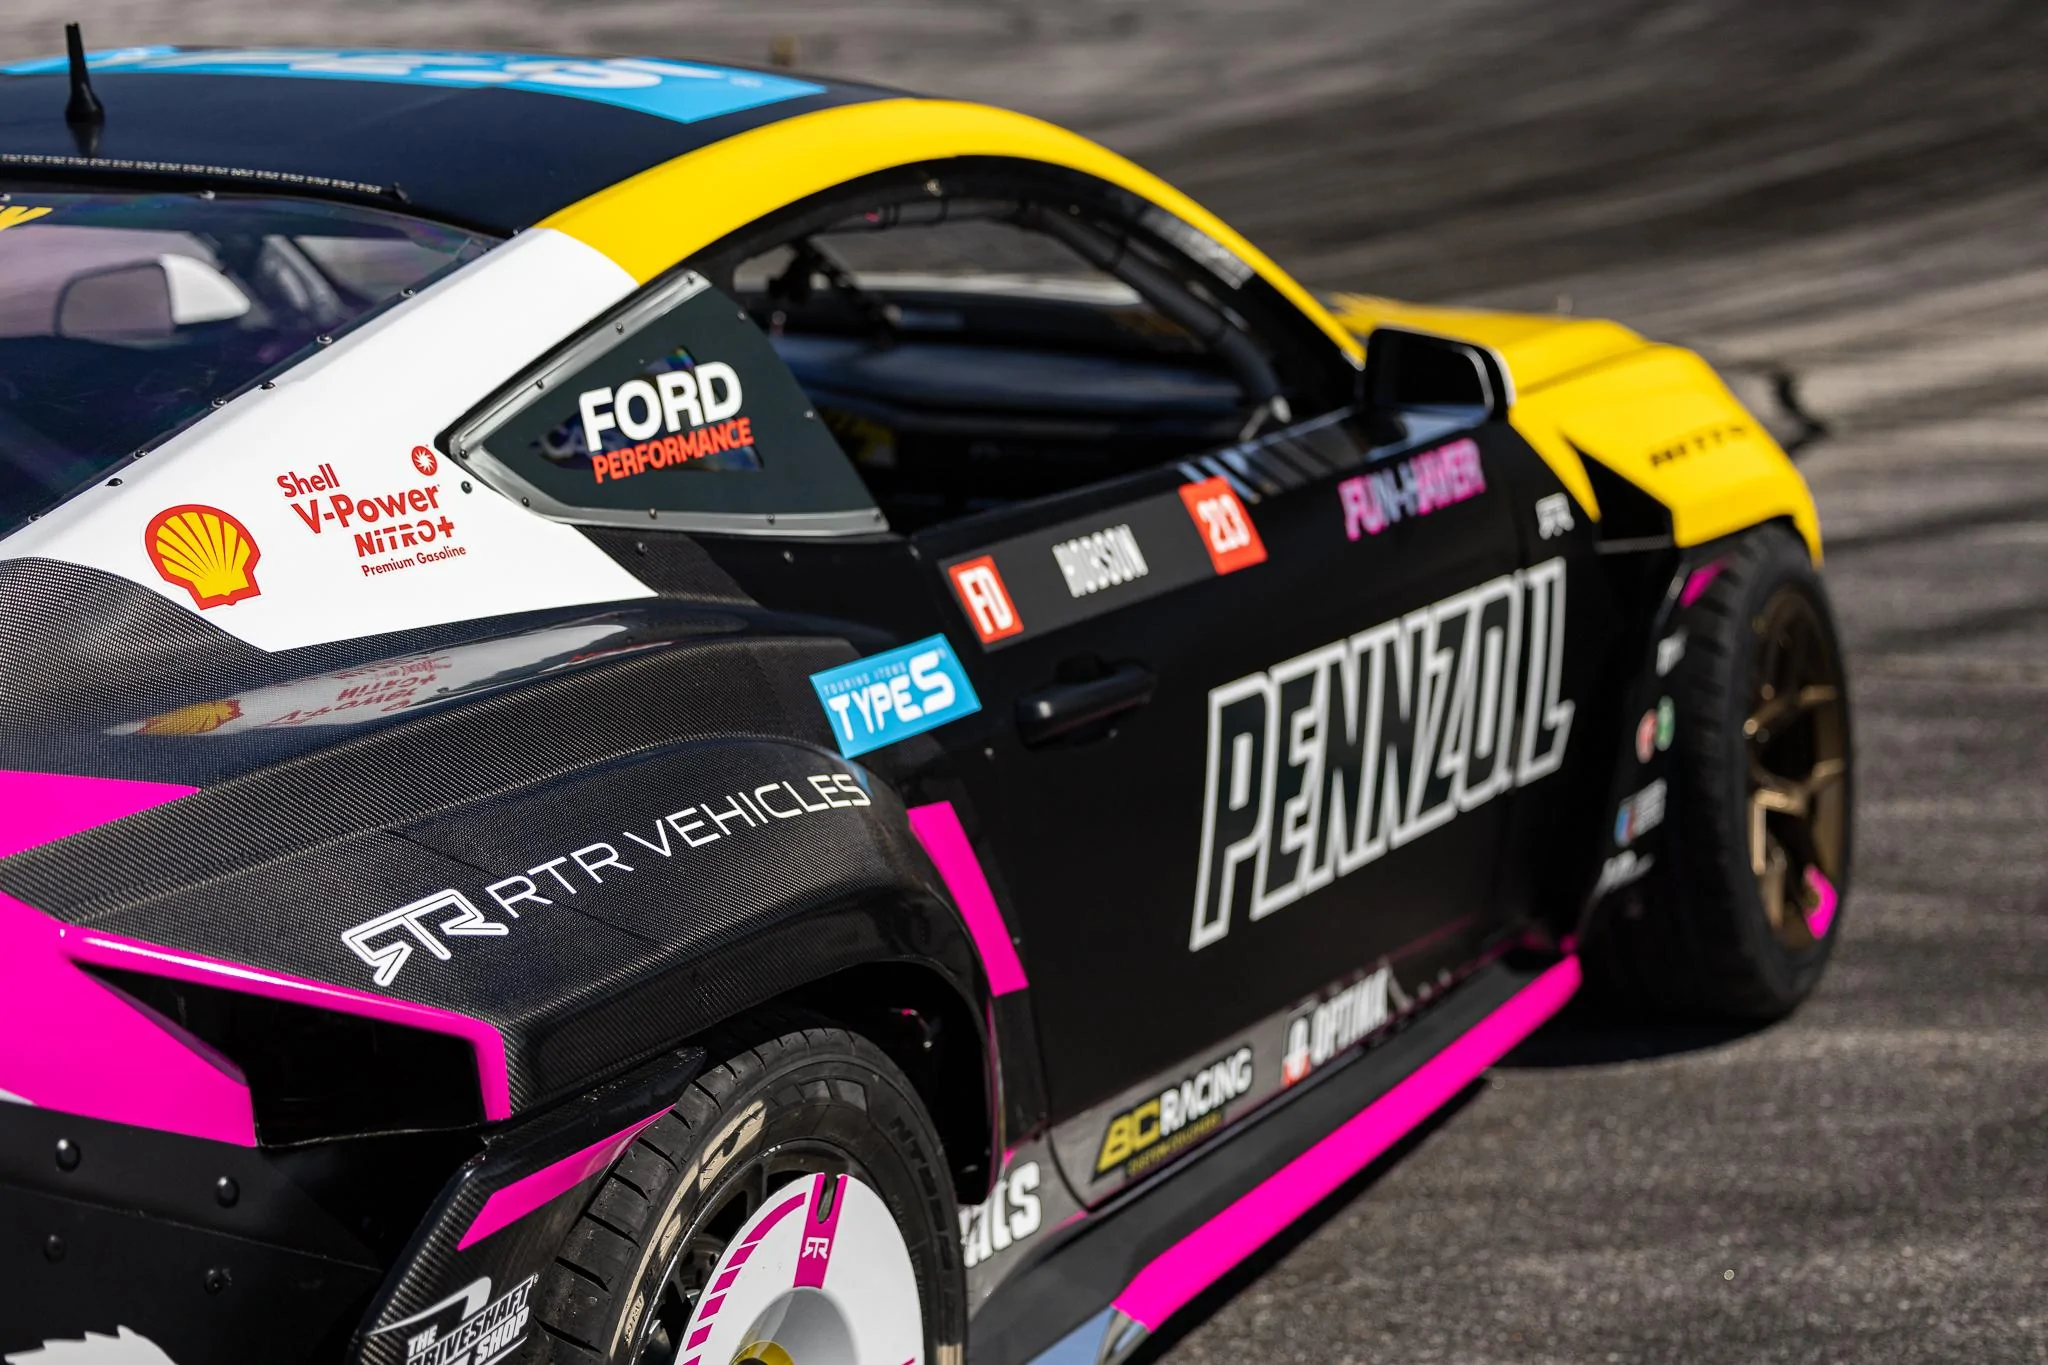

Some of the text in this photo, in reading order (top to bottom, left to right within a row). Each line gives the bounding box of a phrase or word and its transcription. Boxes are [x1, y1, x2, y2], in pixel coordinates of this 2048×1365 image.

[578, 361, 743, 453] FORD
[277, 463, 340, 498] Shell
[591, 416, 755, 484] PERFORMANCE
[290, 484, 440, 534] V-Power
[361, 543, 467, 577] Premium Gasoline
[1188, 556, 1576, 953] PENNZOIL
[485, 842, 634, 918] RTR
[622, 773, 873, 858] VEHICLES
[406, 1274, 536, 1365] DRIVESHAFT
[407, 1323, 439, 1357] THE
[474, 1305, 530, 1365] SHOP
